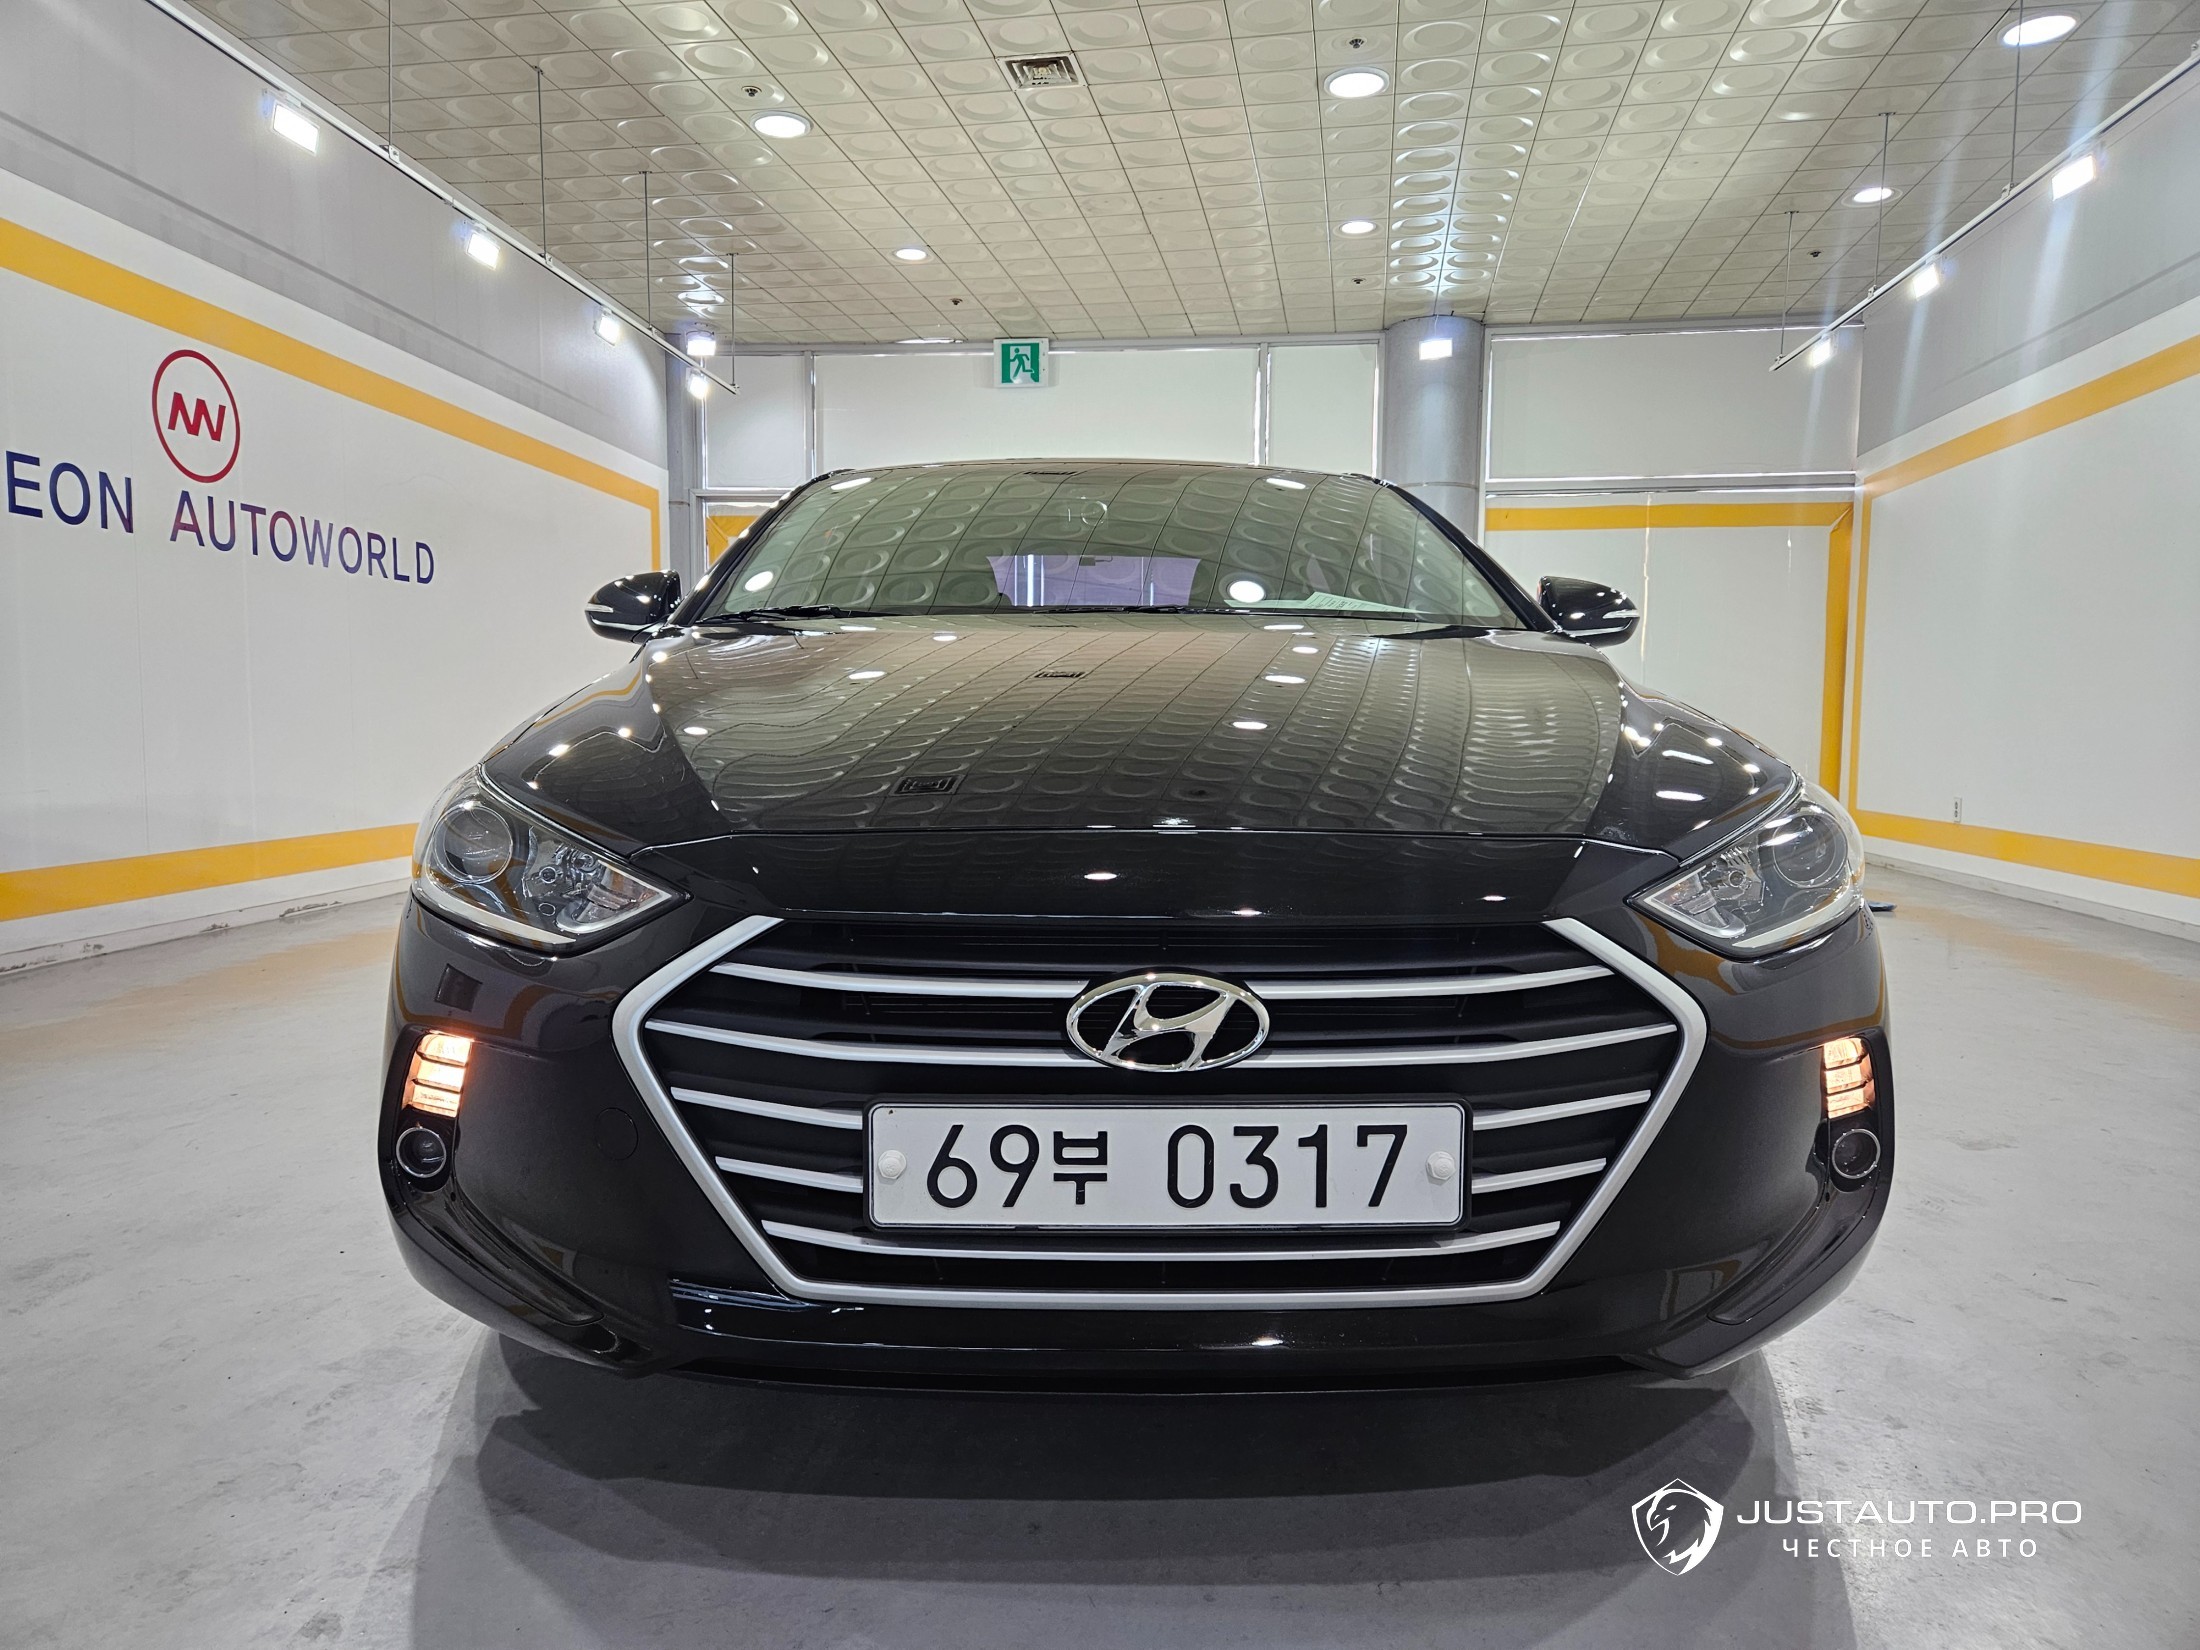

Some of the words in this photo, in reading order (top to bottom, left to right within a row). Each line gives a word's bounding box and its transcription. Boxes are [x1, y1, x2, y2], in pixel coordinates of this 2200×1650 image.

[5, 450, 134, 534] EON
[170, 490, 435, 585] AUTOWORLD
[926, 1124, 1108, 1209] 69부
[1167, 1124, 1408, 1209] 0317
